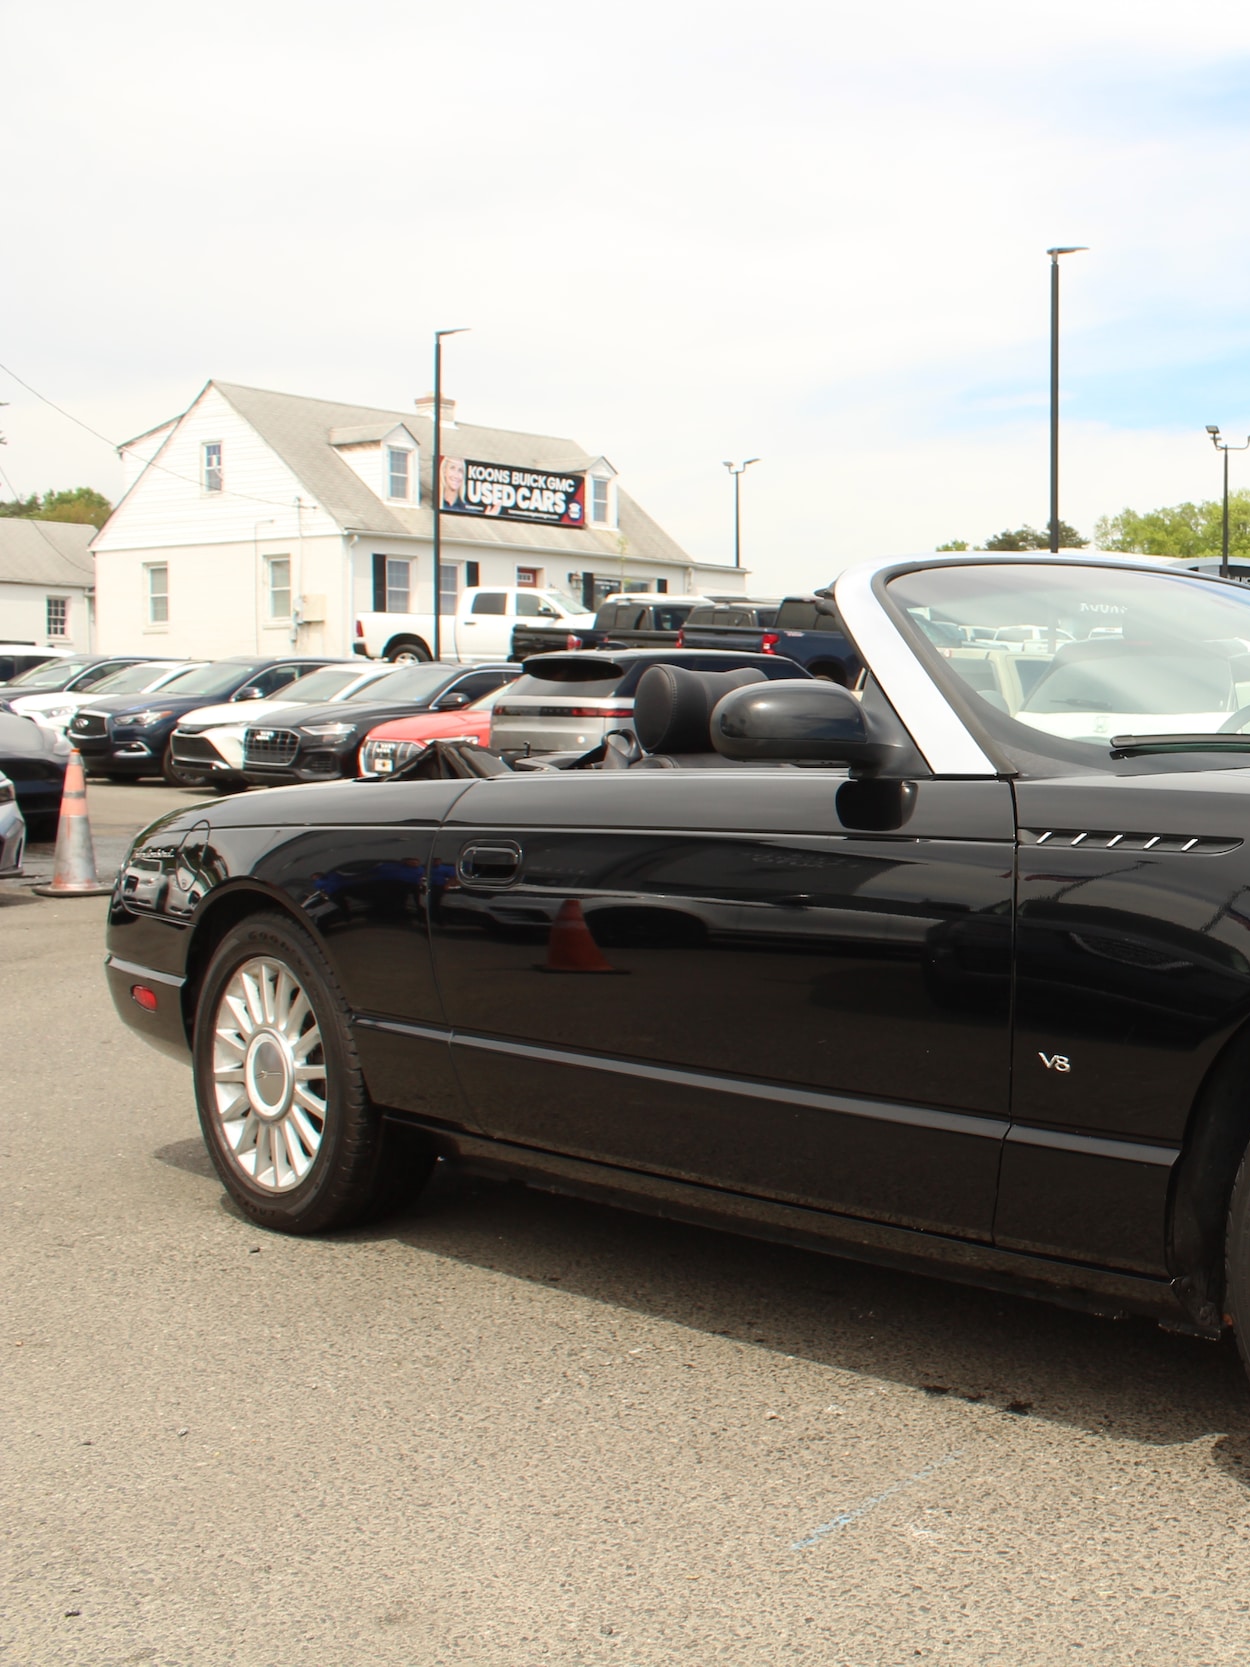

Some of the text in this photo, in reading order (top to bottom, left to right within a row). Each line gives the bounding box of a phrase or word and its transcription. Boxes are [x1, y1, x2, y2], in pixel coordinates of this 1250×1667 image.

[468, 465, 575, 493] KOONS BUICK GMC
[467, 480, 516, 507] USED
[516, 487, 566, 514] CARS
[1039, 1052, 1070, 1072] V8
